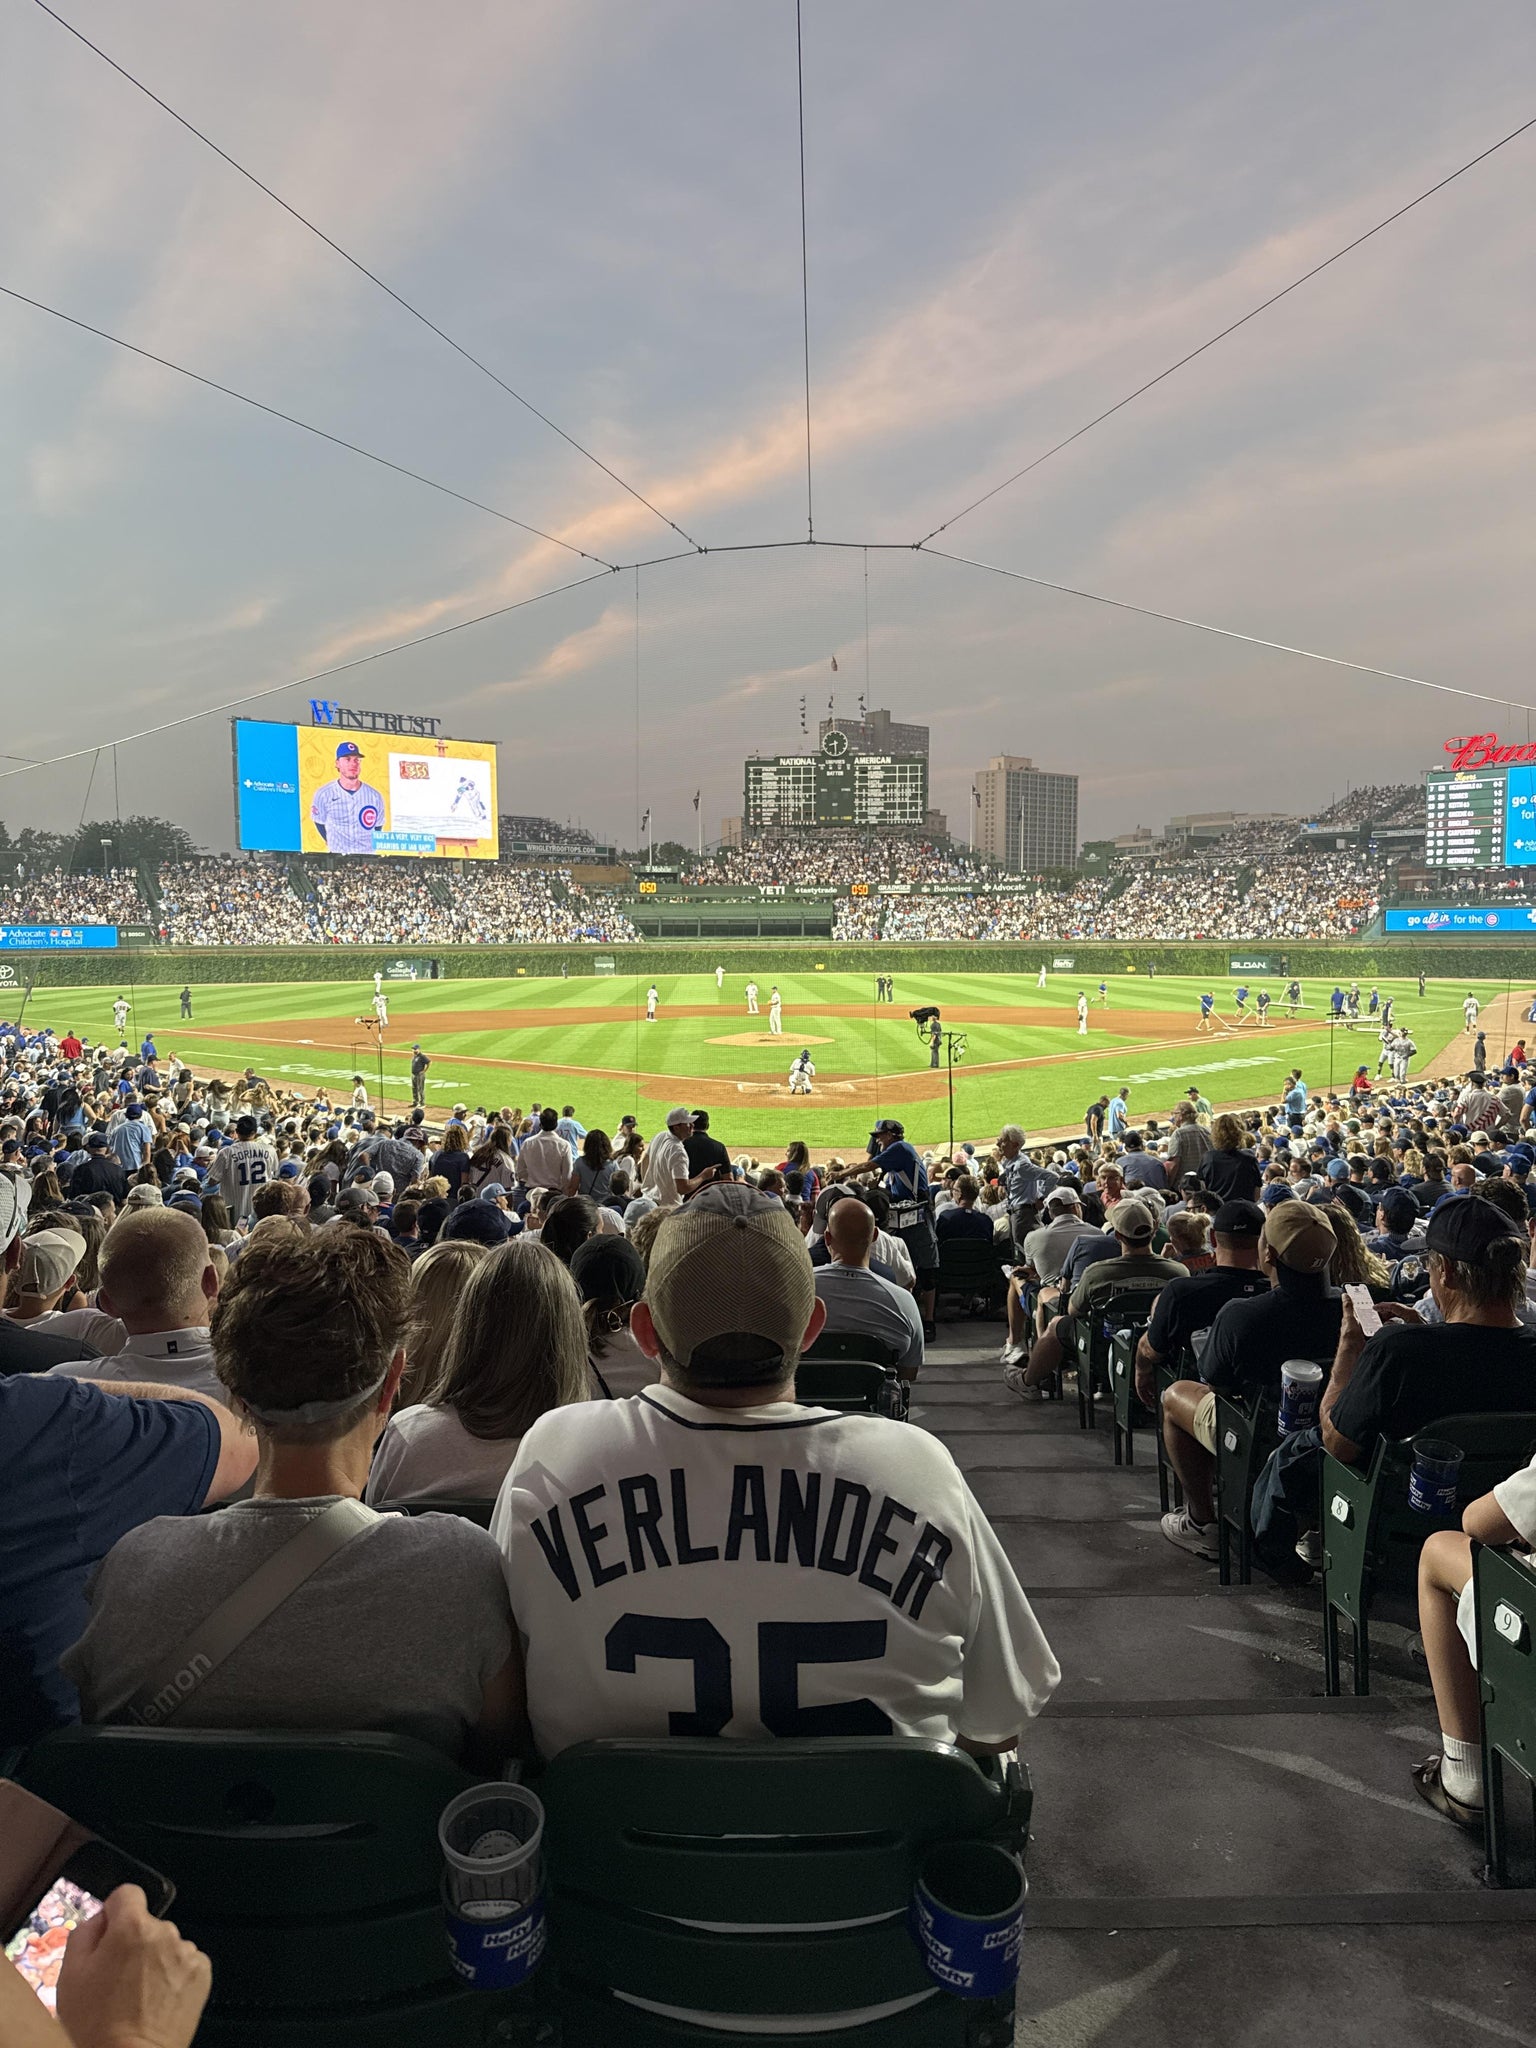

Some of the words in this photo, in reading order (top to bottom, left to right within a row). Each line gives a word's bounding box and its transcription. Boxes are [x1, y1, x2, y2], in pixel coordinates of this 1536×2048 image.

[308, 698, 442, 736] WINTRUST
[1512, 796, 1527, 807] go
[758, 885, 785, 895] YETI
[800, 886, 838, 895] tastytrade
[933, 885, 973, 893] Budweiser
[1407, 916, 1421, 926] go
[1422, 912, 1439, 924] all
[1440, 911, 1450, 922] in
[1453, 914, 1467, 923] for
[1468, 914, 1483, 923] the
[8, 929, 46, 939] Advocate
[8, 937, 49, 946] Children's
[50, 937, 83, 947] Hospital
[231, 1149, 269, 1163] SORIANO
[238, 1161, 266, 1185] 12
[1337, 1502, 1343, 1516] 8
[530, 1465, 952, 1621] VERLANDER
[1502, 1612, 1512, 1631] 9
[605, 1613, 894, 1737] 35
[486, 1920, 531, 1946] Hefty
[929, 1958, 970, 1985] Hefty
